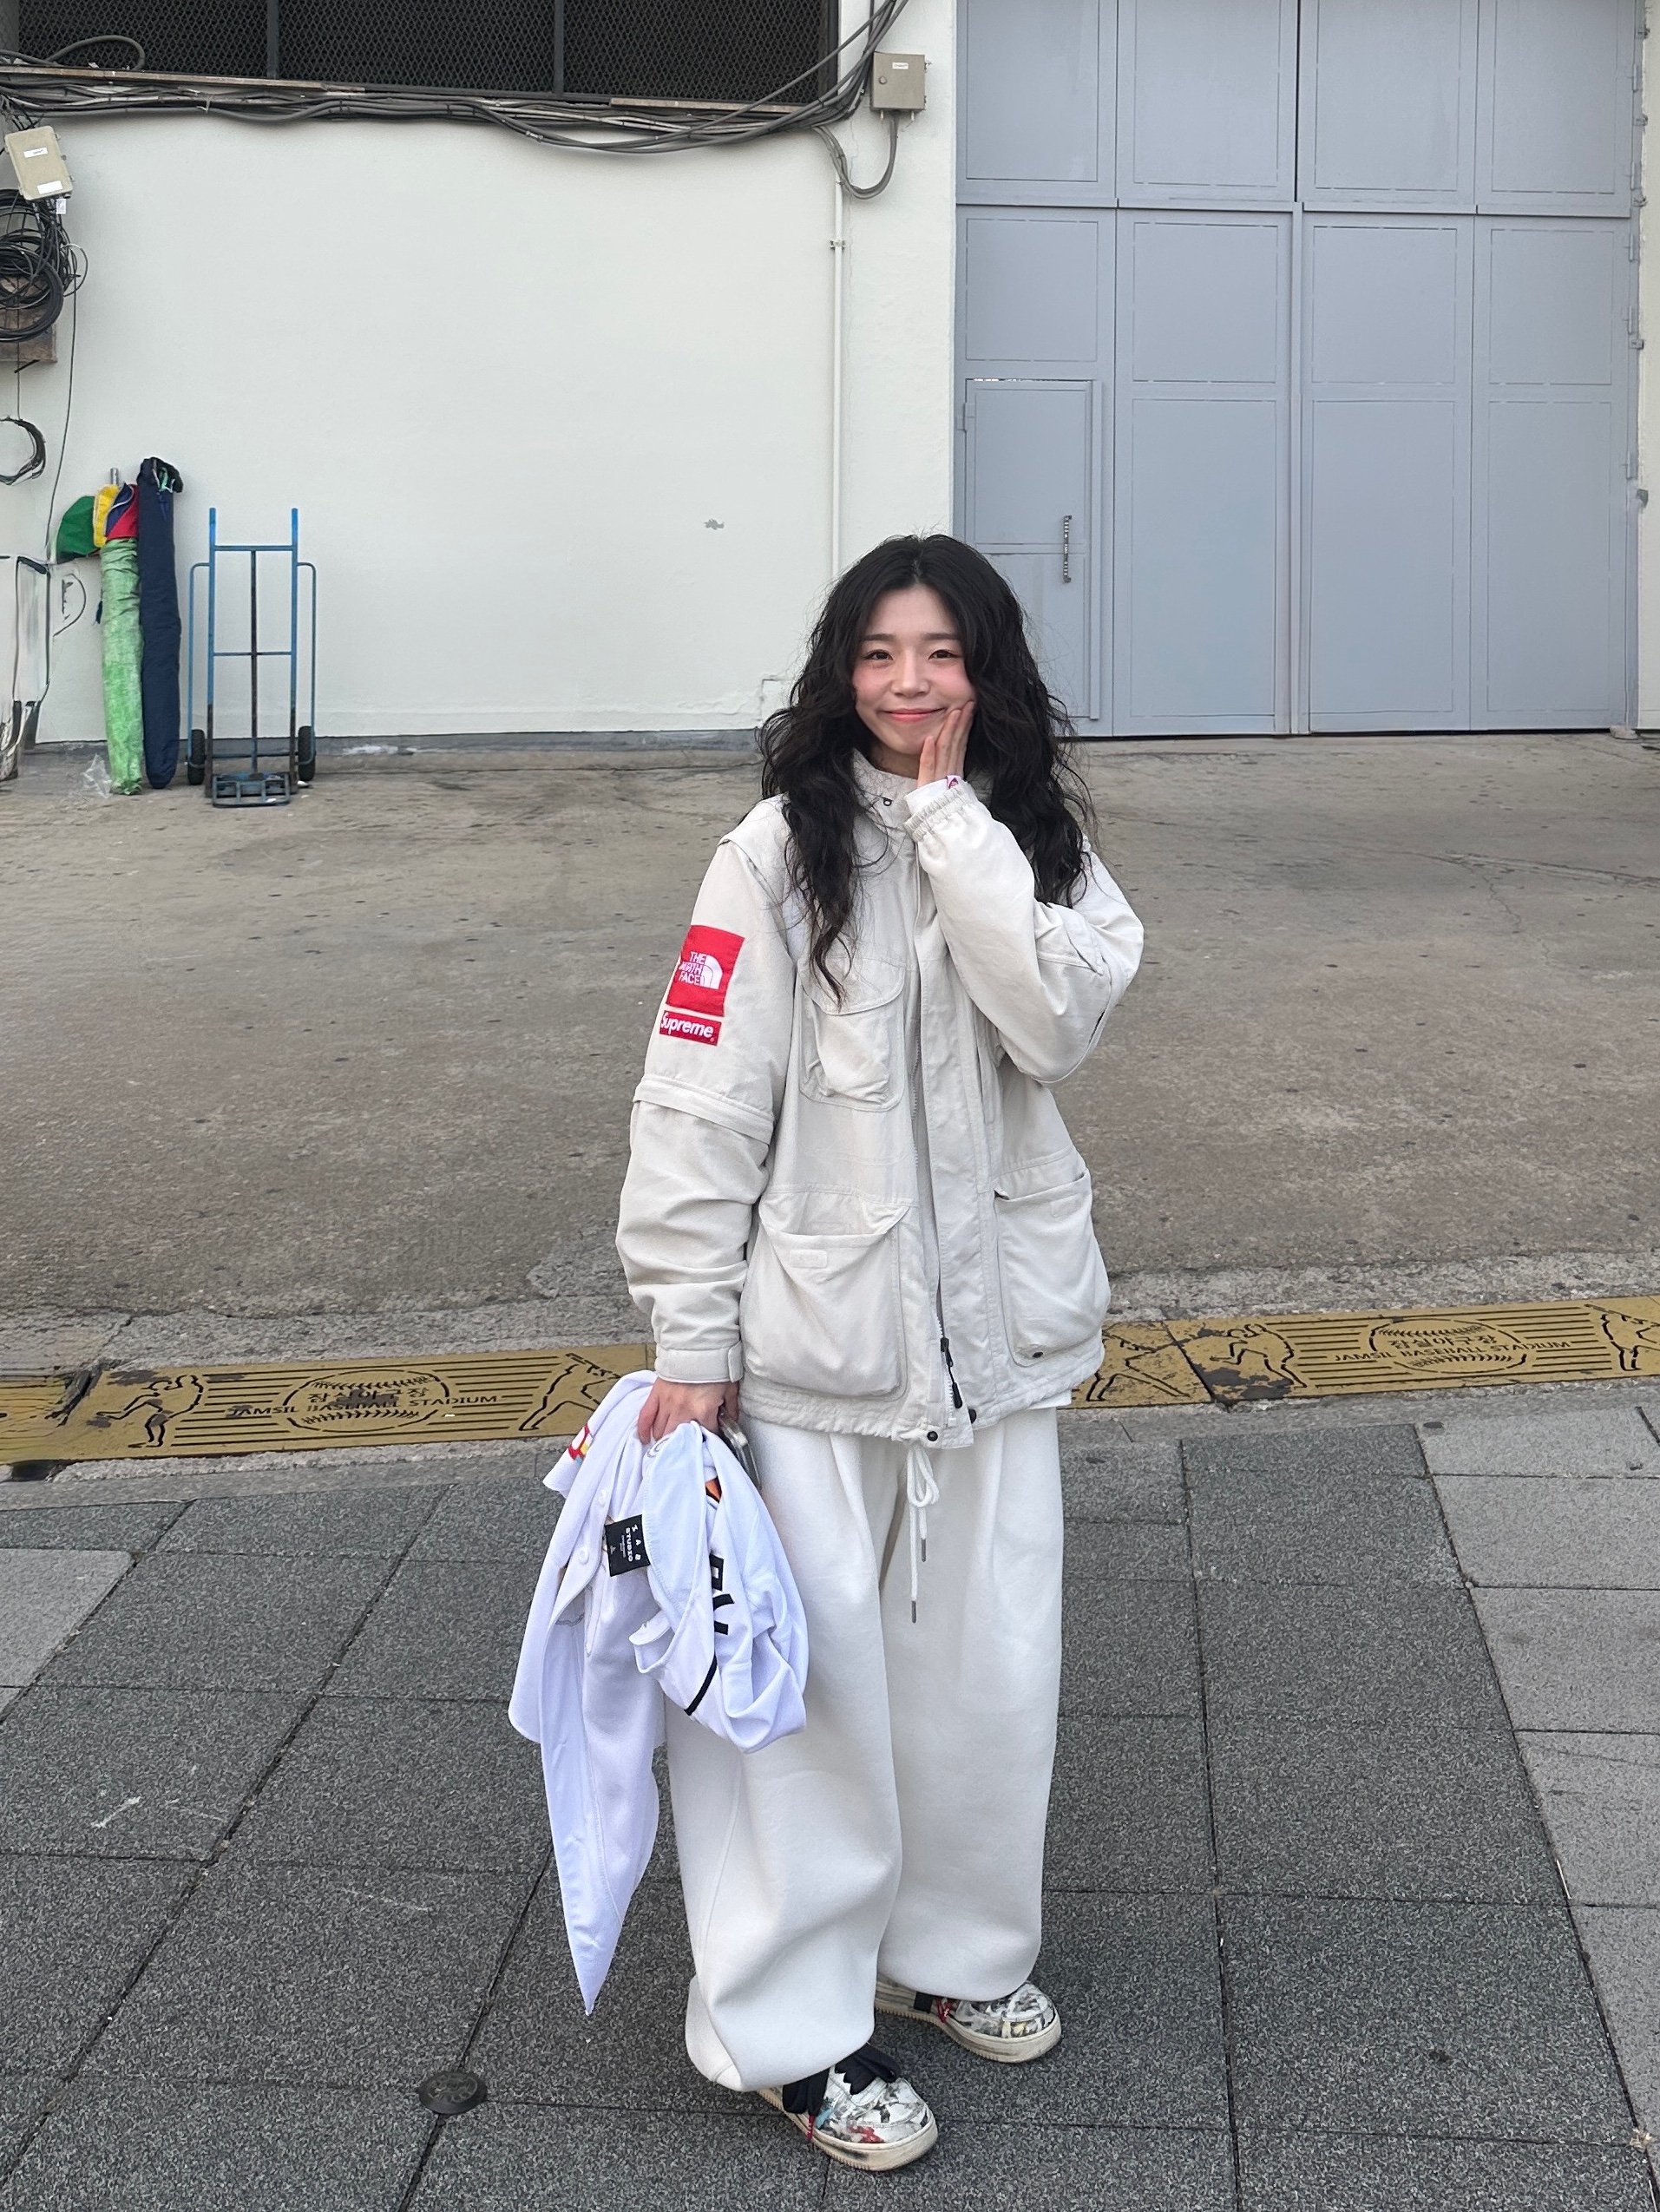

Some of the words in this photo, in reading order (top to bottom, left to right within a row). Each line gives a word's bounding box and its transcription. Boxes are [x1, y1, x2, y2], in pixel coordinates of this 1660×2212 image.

[690, 951, 706, 964] THE
[679, 972, 700, 985] FACE
[661, 1012, 714, 1038] Supreme
[1335, 1351, 1396, 1362] JAMSIL
[1401, 1346, 1487, 1358] BASEBALL
[1490, 1341, 1571, 1353] STADIUM
[229, 1406, 299, 1416] JAMSIL
[409, 1395, 497, 1407] STADIUM
